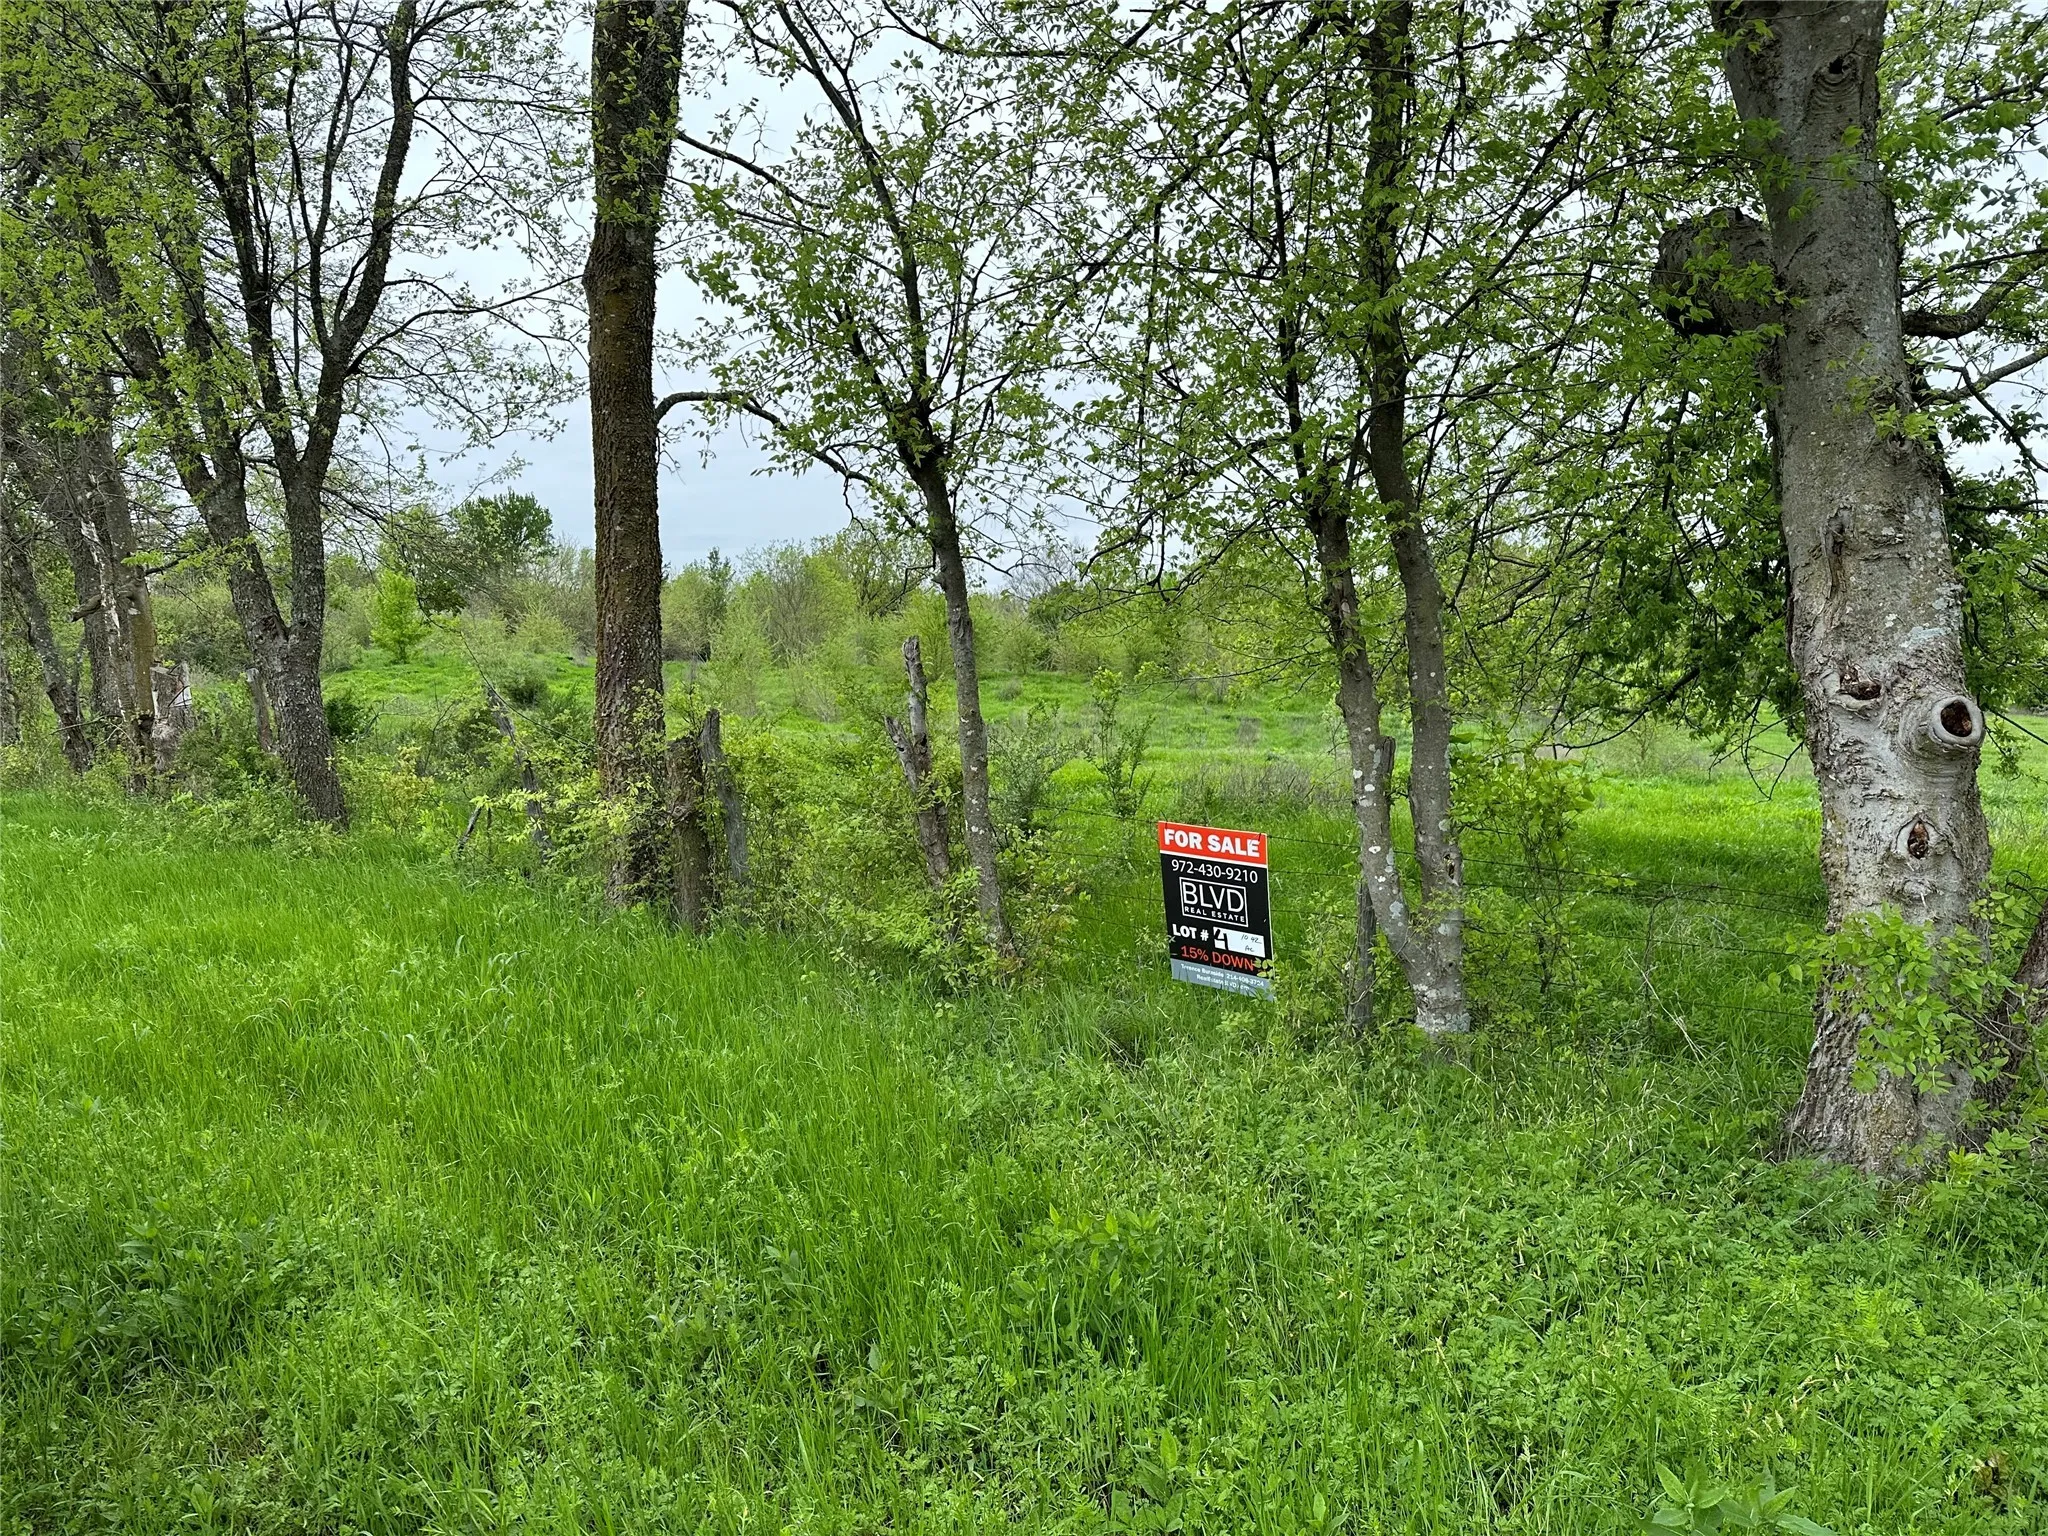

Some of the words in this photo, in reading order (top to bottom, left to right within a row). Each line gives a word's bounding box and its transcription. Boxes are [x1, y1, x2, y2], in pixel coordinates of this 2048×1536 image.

[1164, 828, 1202, 850] FOR
[1207, 834, 1260, 857] SALE
[1171, 859, 1258, 883] 972-430-9210
[1182, 881, 1244, 912] BLVD
[1184, 906, 1207, 916] REAL
[1212, 910, 1245, 923] ESTATE
[1172, 923, 1197, 939] LOT
[1200, 929, 1209, 942] #
[1181, 945, 1209, 961] 15%
[1212, 951, 1254, 972] DOWN
